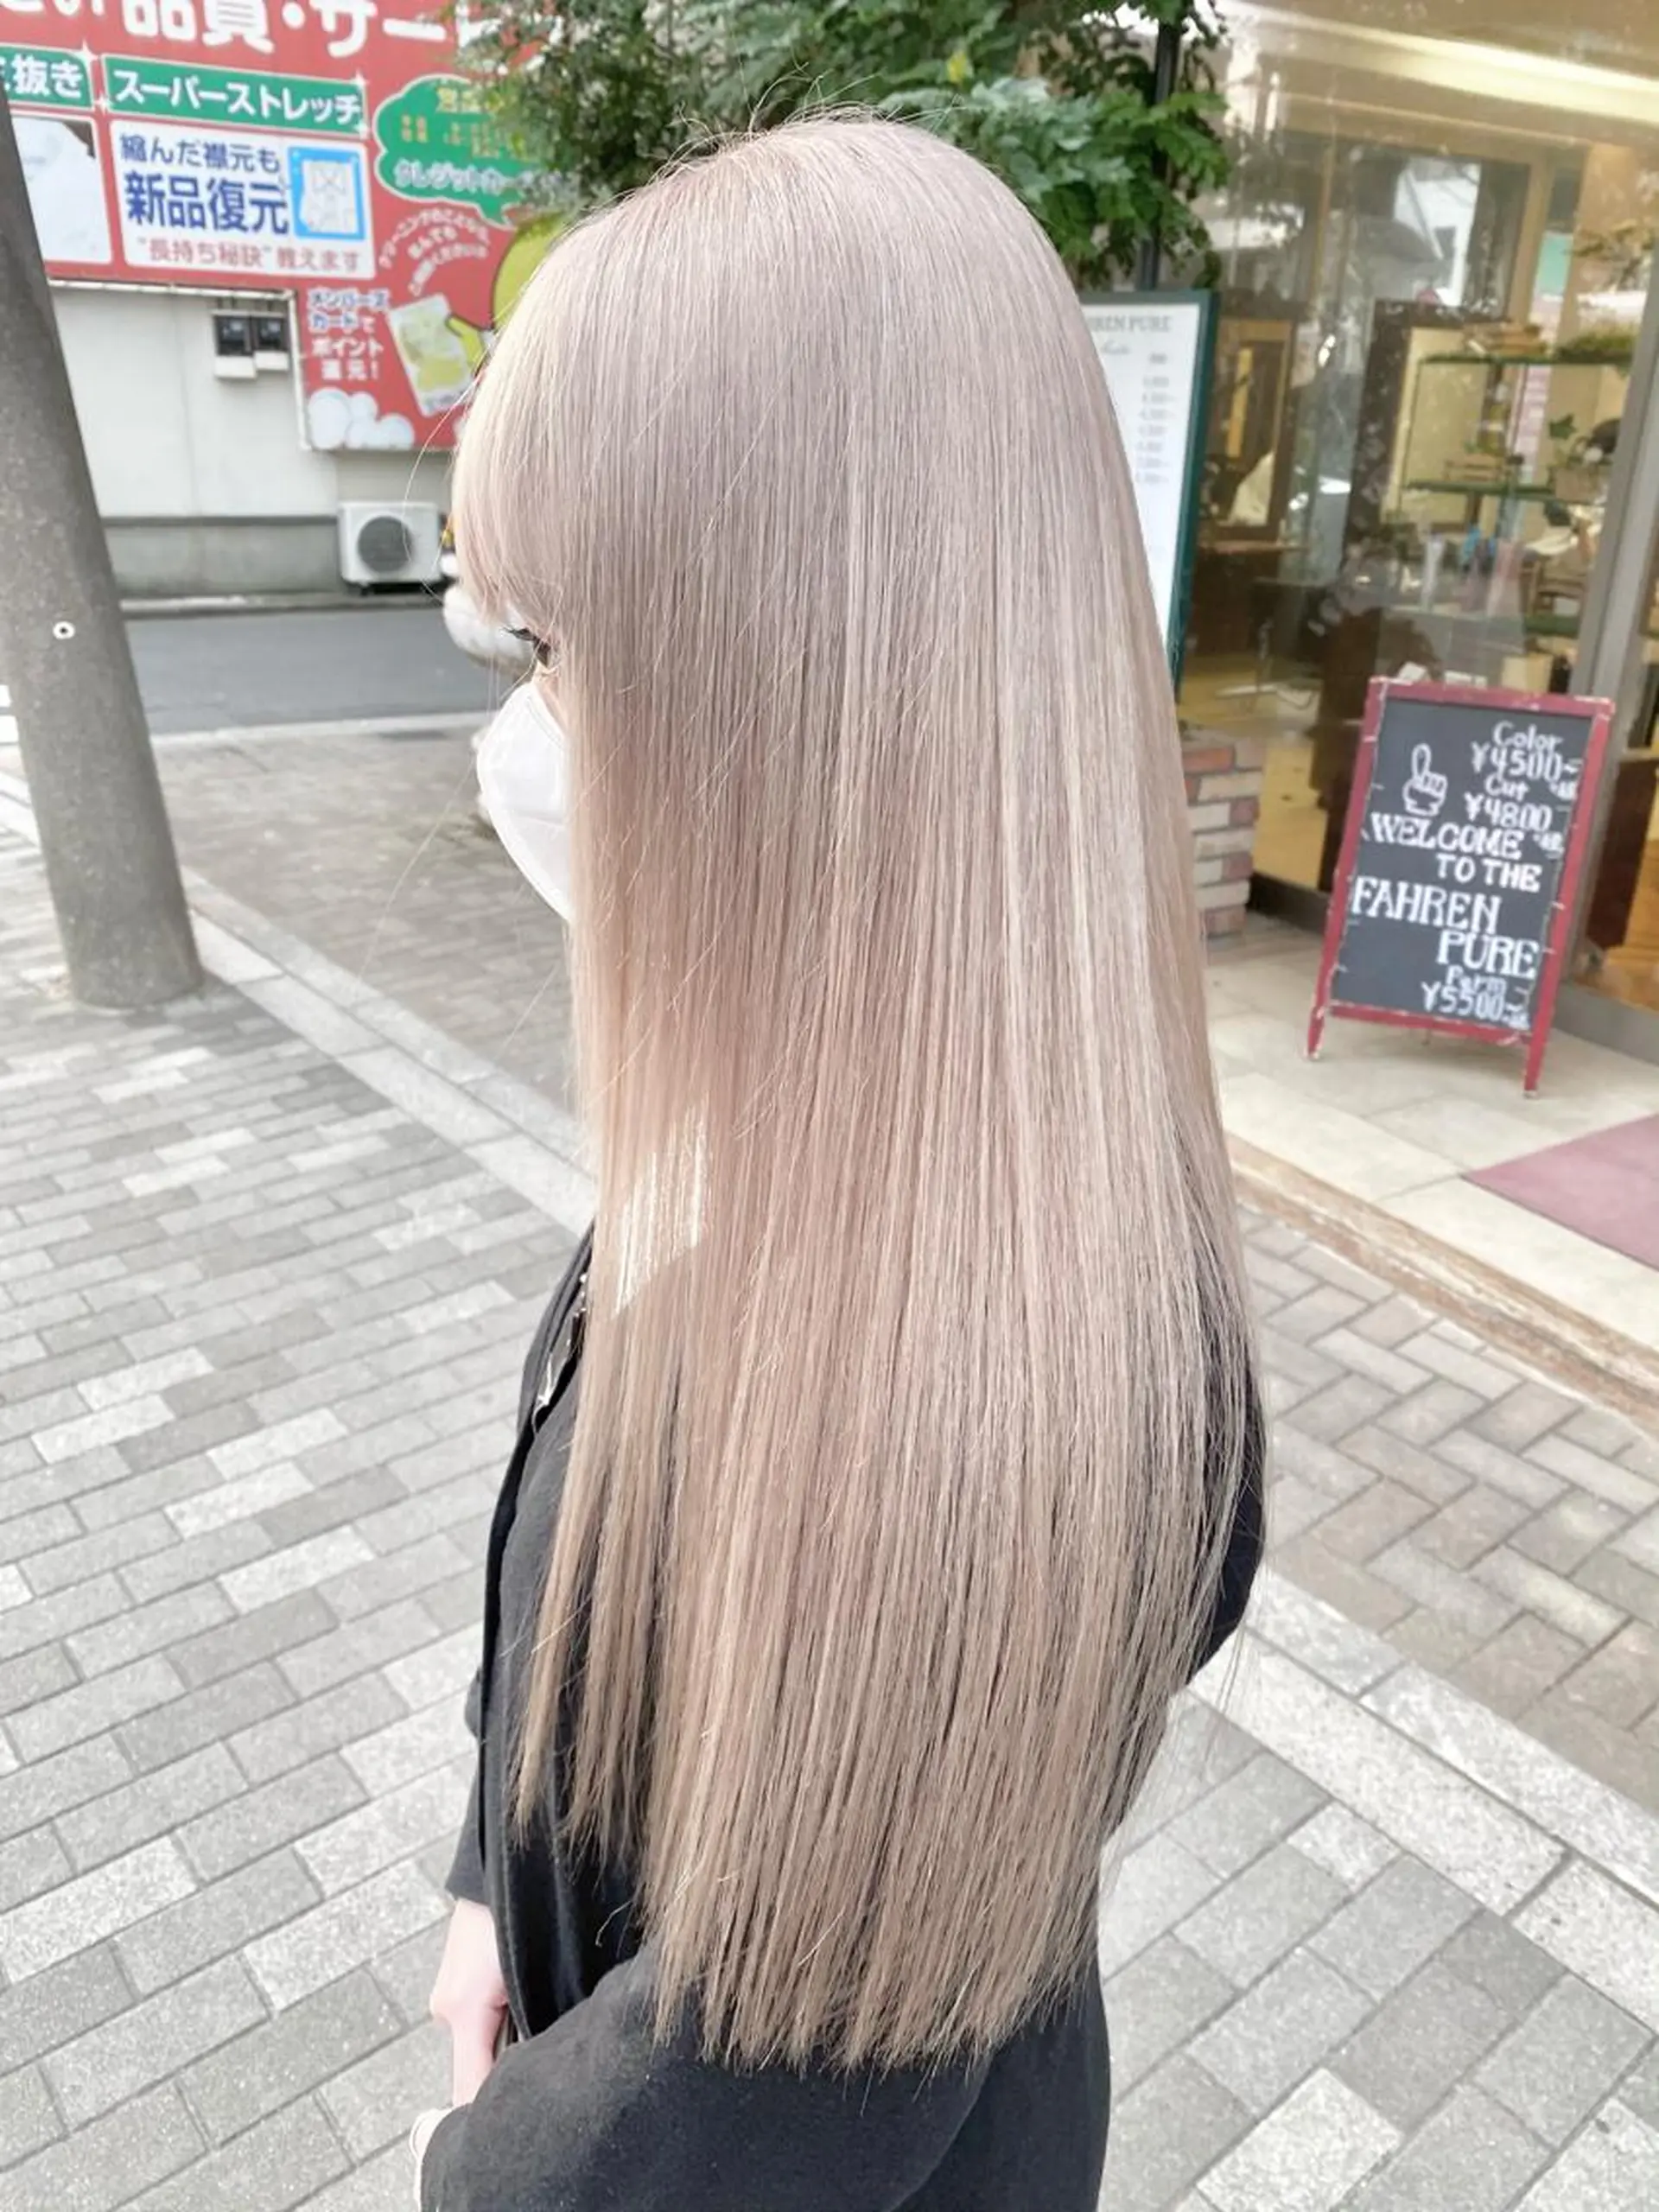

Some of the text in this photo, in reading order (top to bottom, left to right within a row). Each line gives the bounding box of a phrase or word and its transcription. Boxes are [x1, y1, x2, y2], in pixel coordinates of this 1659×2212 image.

[0, 54, 83, 99] 抜き
[113, 68, 360, 125] スーパーストレッチ
[124, 170, 290, 235] 新品復元
[1492, 720, 1564, 751] Color
[1464, 791, 1553, 831] ¥4800
[1484, 773, 1529, 802] Cut
[1370, 812, 1524, 861] WELCOME
[1435, 853, 1542, 893] TO THE
[1351, 875, 1502, 935] FAHREN
[1436, 929, 1539, 980] PURE
